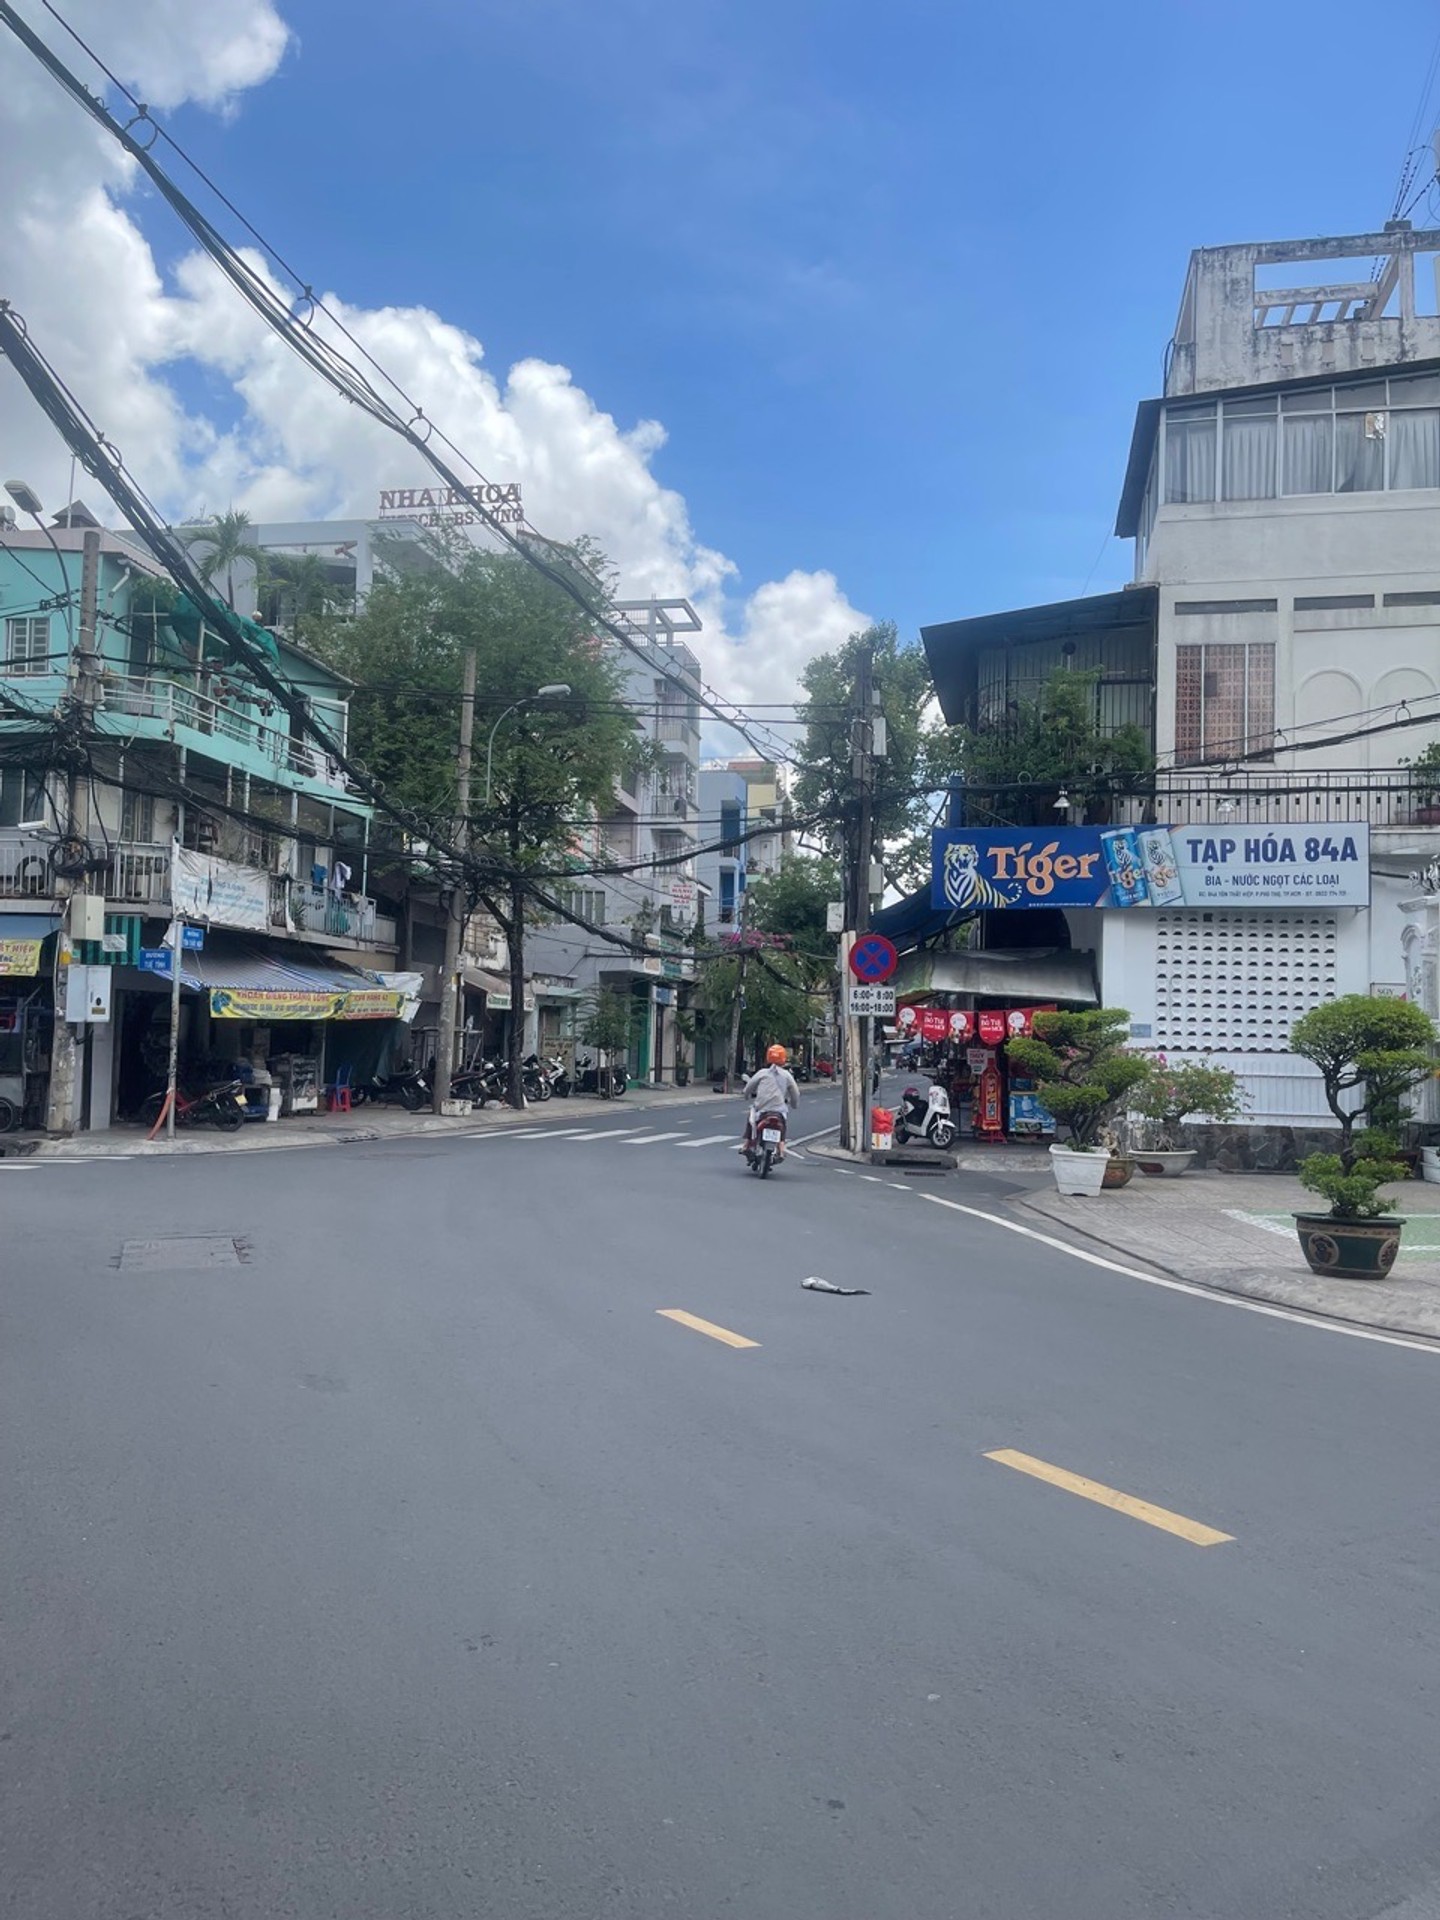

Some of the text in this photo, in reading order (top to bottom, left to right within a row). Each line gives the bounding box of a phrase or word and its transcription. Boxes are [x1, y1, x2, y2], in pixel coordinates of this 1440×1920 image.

[379, 483, 522, 509] NHA KHOA
[454, 512, 474, 526] BS
[1187, 832, 1358, 871] TẠP HÓA 84A
[987, 842, 1100, 895] Tiger
[1205, 875, 1222, 886] BIA
[1232, 872, 1260, 886] NƯỚC
[1263, 874, 1290, 888] NGỌT
[1293, 871, 1313, 885] CÁC
[1316, 874, 1339, 888] LOẠI
